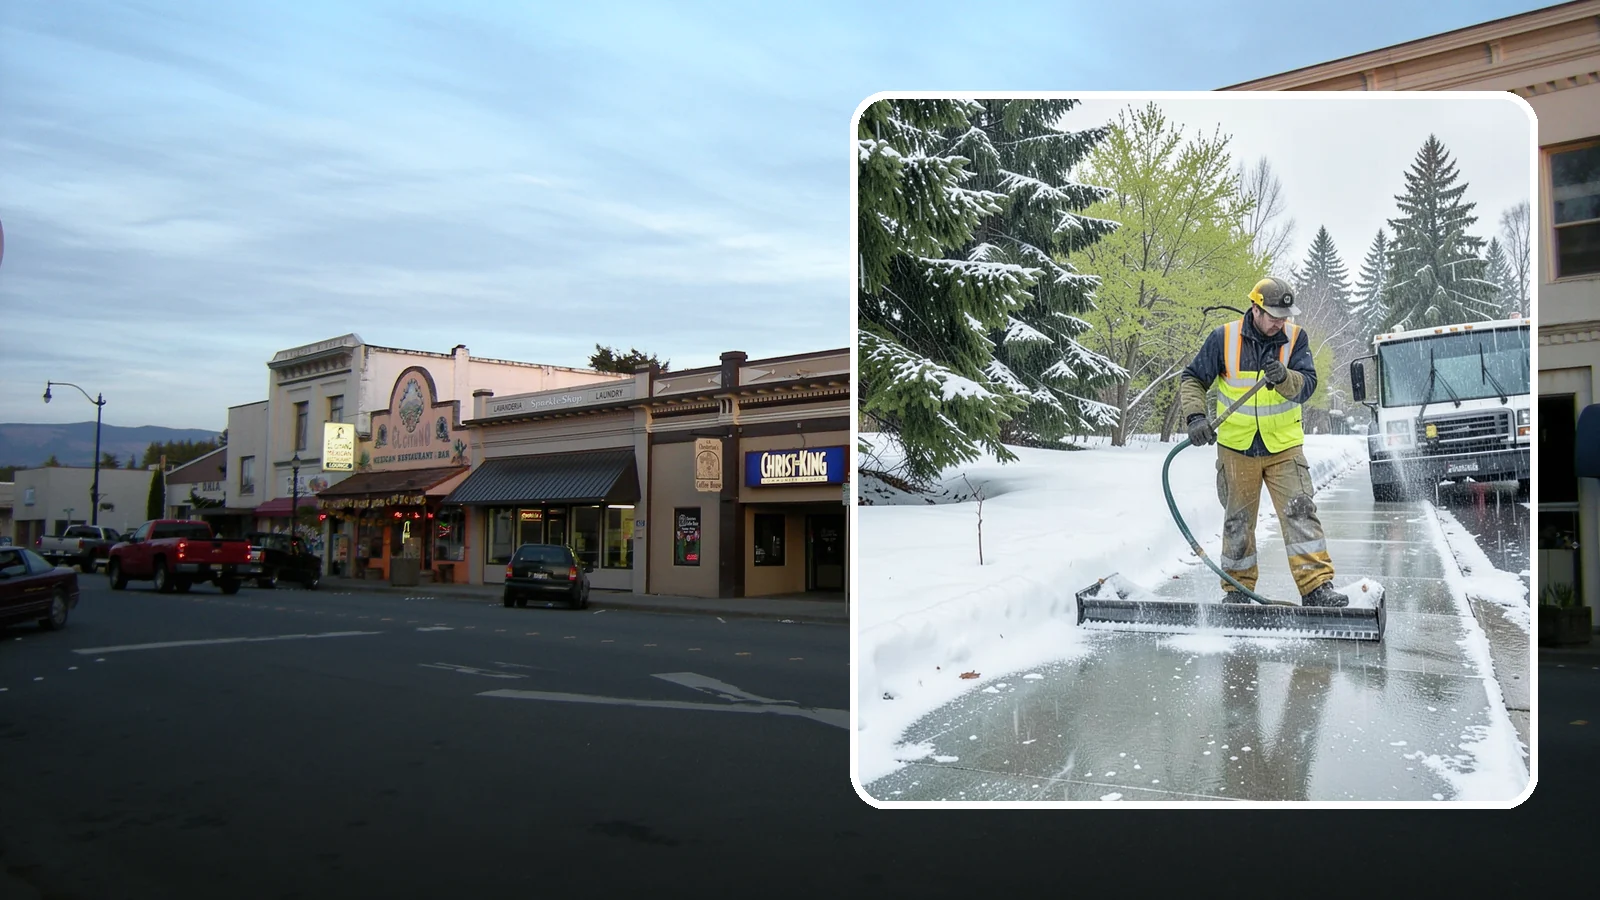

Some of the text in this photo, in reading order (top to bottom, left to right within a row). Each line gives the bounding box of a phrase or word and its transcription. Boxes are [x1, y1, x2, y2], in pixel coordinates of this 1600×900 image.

[531, 394, 582, 408] Sparkle Shop
[595, 389, 624, 400] LAUNDRY
[493, 402, 522, 412] LAVANDERIA
[373, 455, 396, 464] MEXICAN
[397, 451, 433, 462] RESTAURANT
[438, 450, 450, 458] BAR
[760, 450, 827, 478] CHRIST KING
